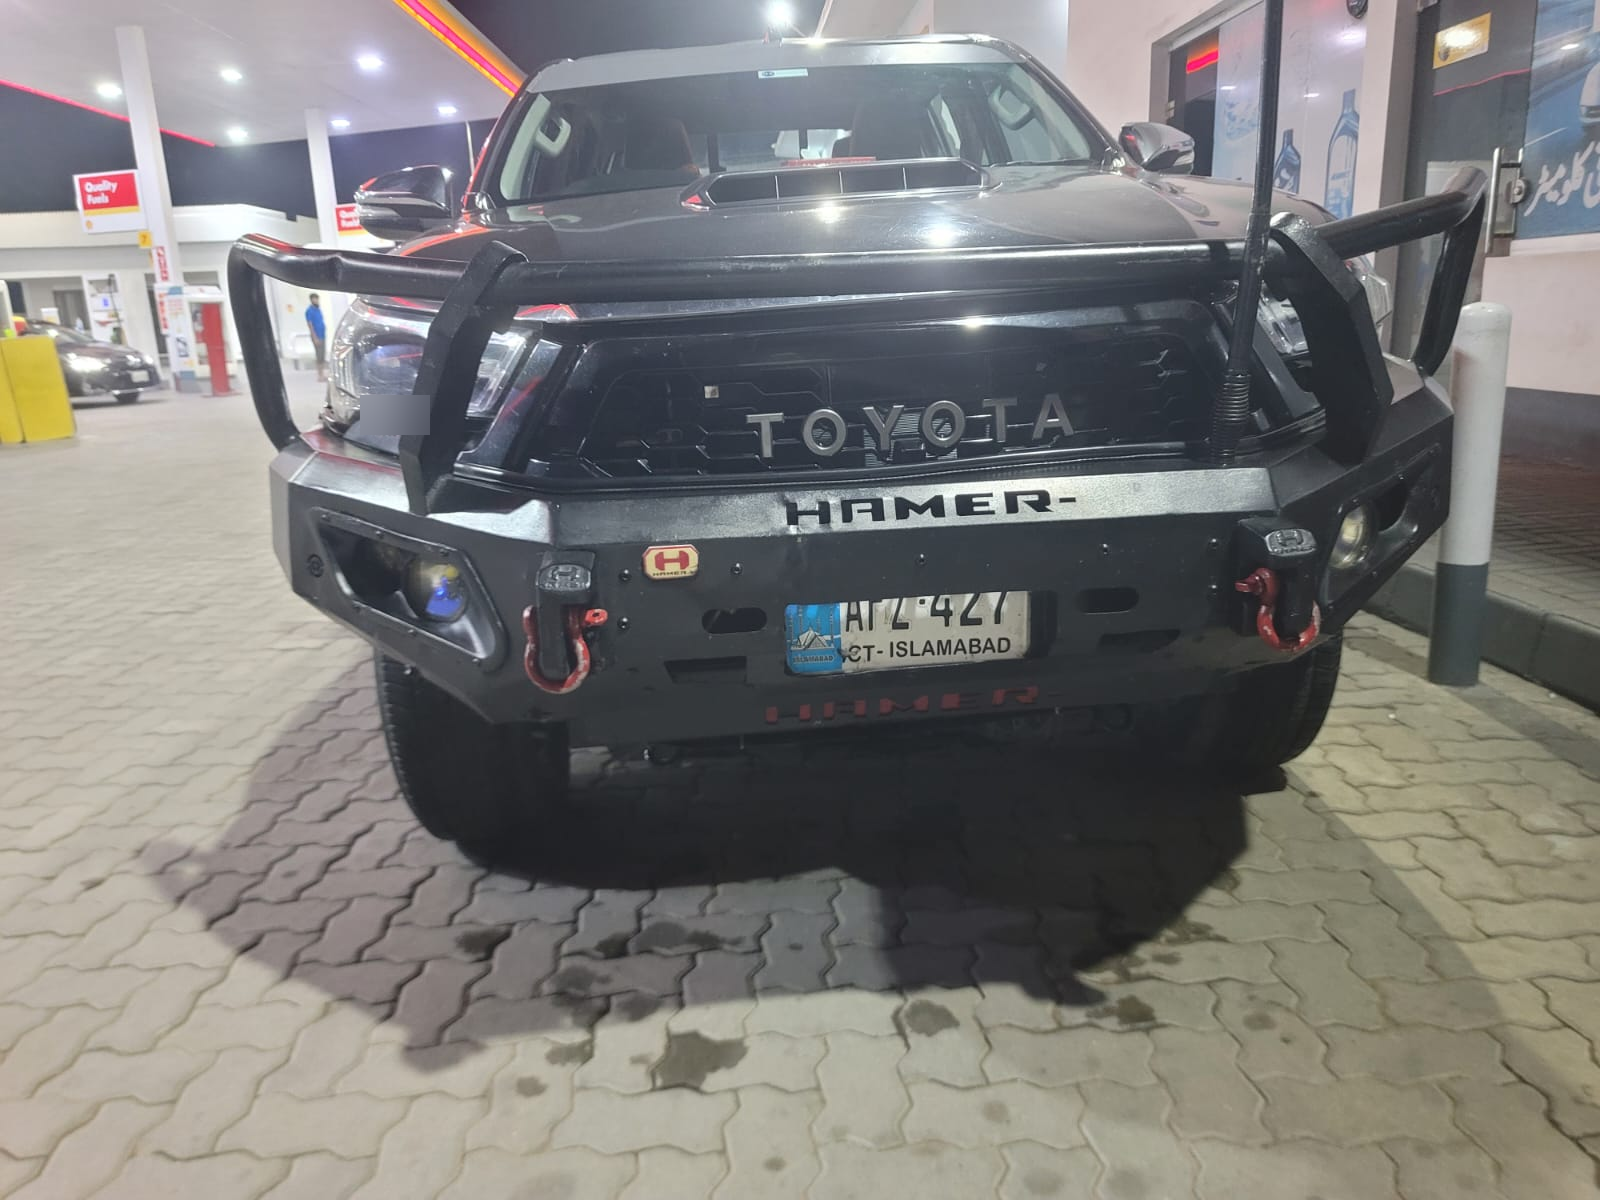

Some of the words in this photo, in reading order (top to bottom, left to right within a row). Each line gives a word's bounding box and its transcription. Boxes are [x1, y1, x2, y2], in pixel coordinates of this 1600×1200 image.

[84, 180, 118, 194] Quality
[86, 193, 110, 205] Fuels
[746, 393, 1075, 458] TOYOTA
[841, 645, 884, 664] CT-
[889, 637, 1012, 659] ISLAMABAD
[793, 655, 835, 664] ISLAMABAD
